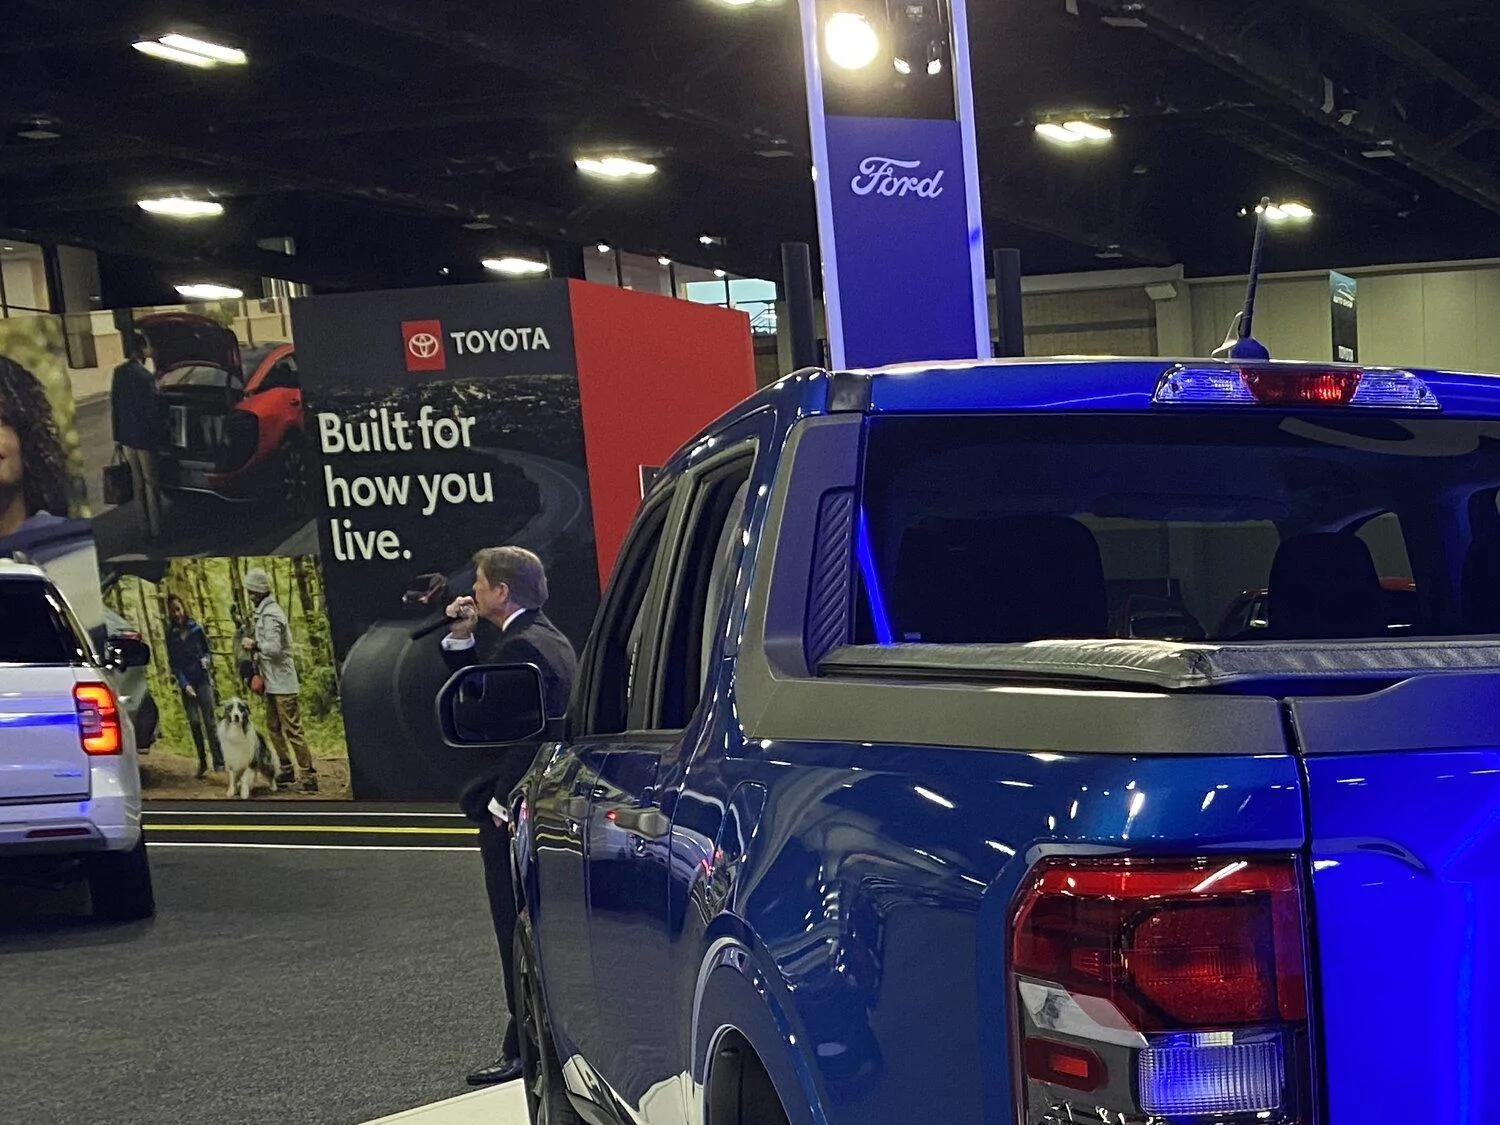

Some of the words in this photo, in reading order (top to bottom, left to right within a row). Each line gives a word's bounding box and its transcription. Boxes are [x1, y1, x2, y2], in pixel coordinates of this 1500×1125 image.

[850, 156, 944, 198] Ford
[450, 326, 551, 355] TOYOTA
[317, 407, 413, 453] Built
[417, 404, 476, 450] for
[323, 464, 411, 508] how
[416, 471, 494, 516] you
[330, 518, 413, 561] live.
